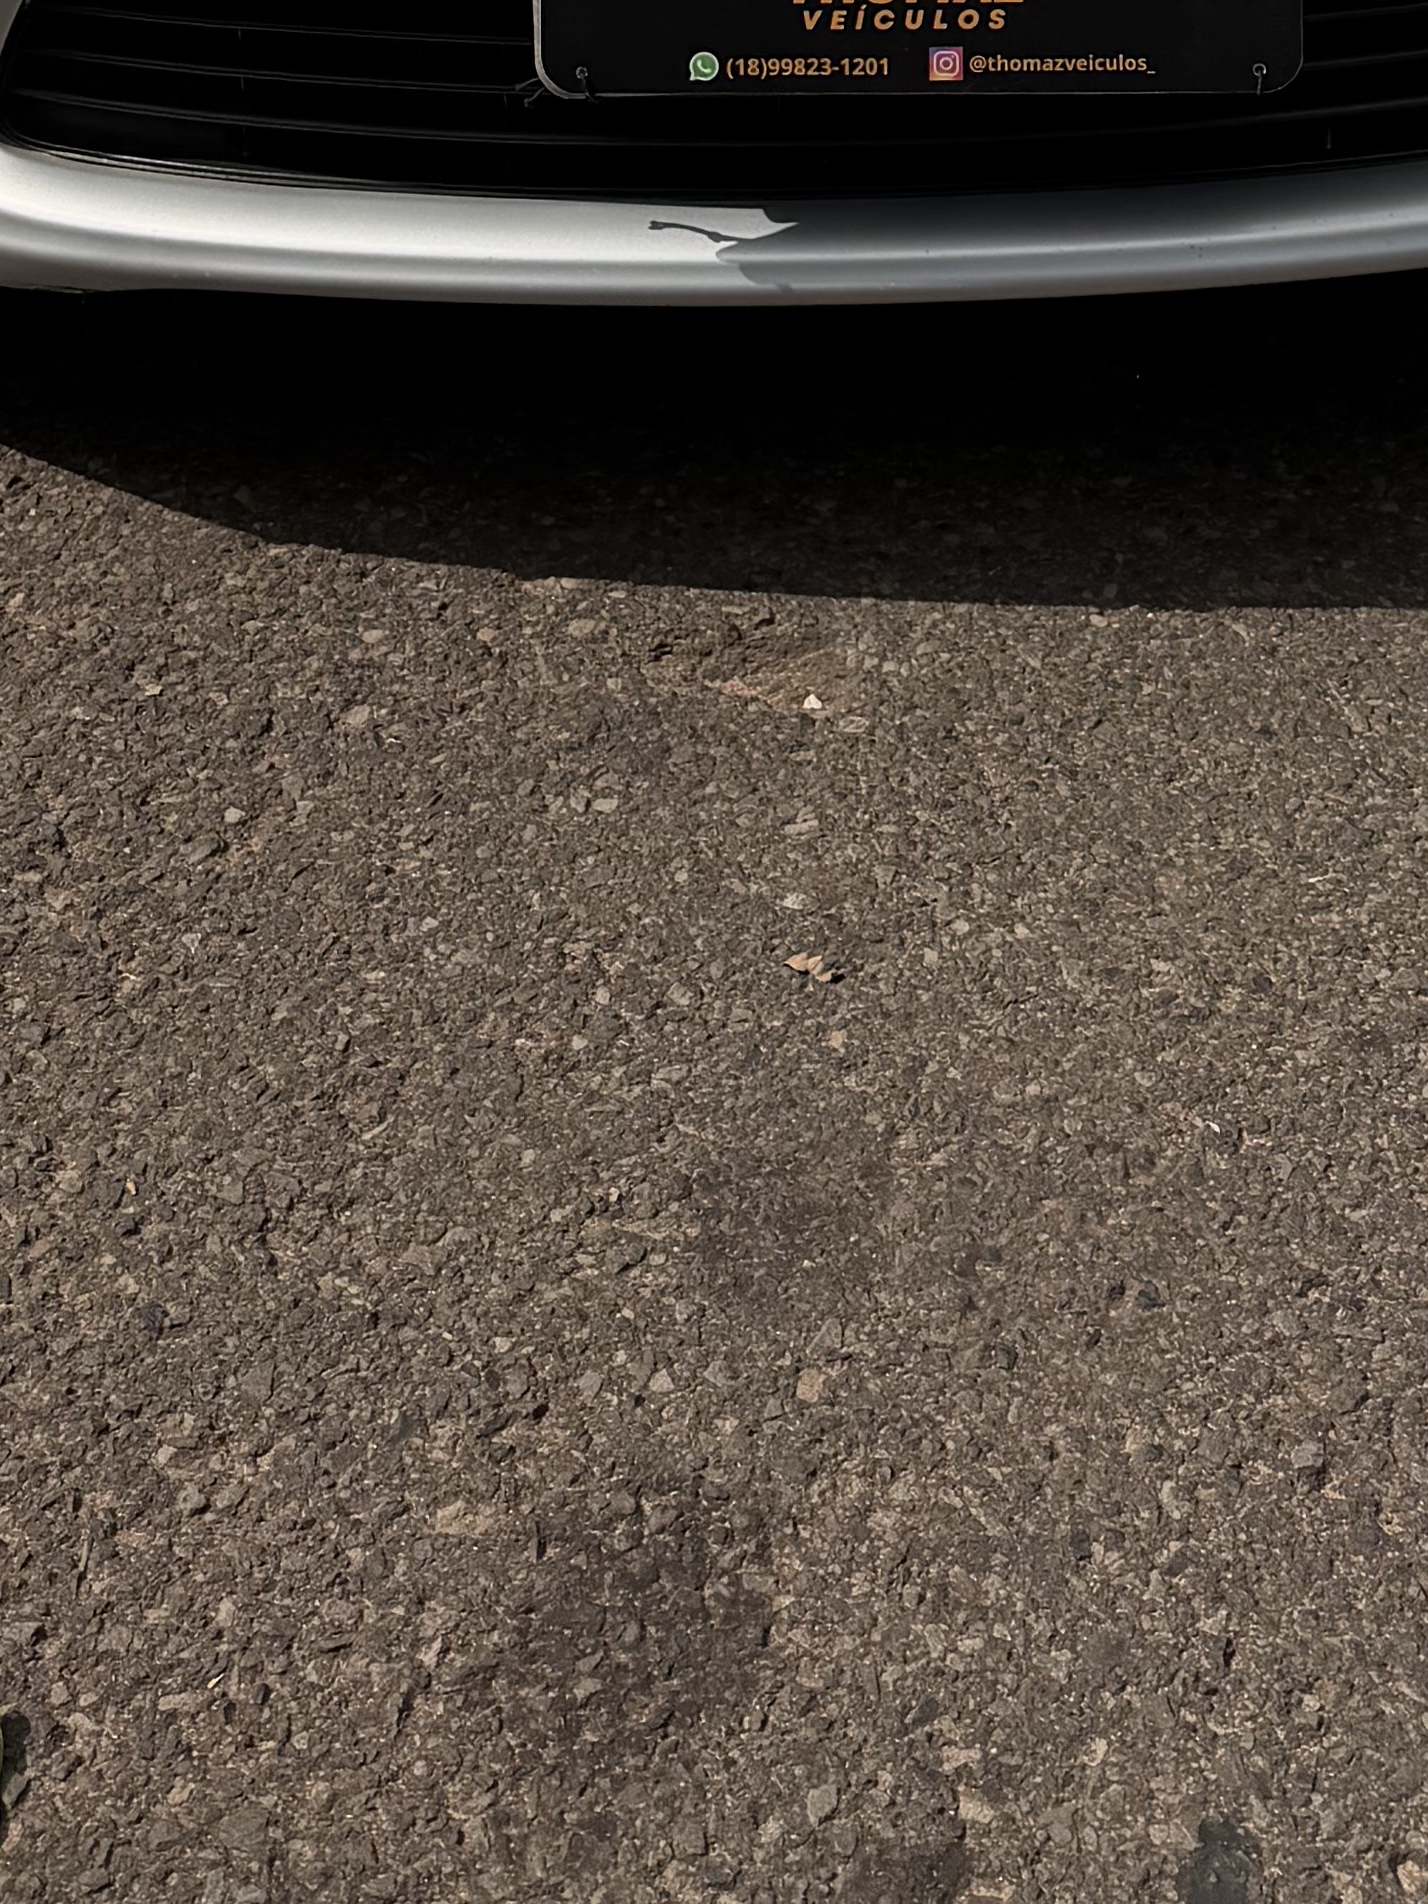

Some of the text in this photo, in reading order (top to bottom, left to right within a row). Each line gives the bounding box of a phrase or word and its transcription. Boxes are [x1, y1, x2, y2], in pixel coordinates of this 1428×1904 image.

[802, 5, 1008, 32] VEÍCULOS
[725, 53, 1156, 80] (18)99823-1201 @thomazveiculos_
